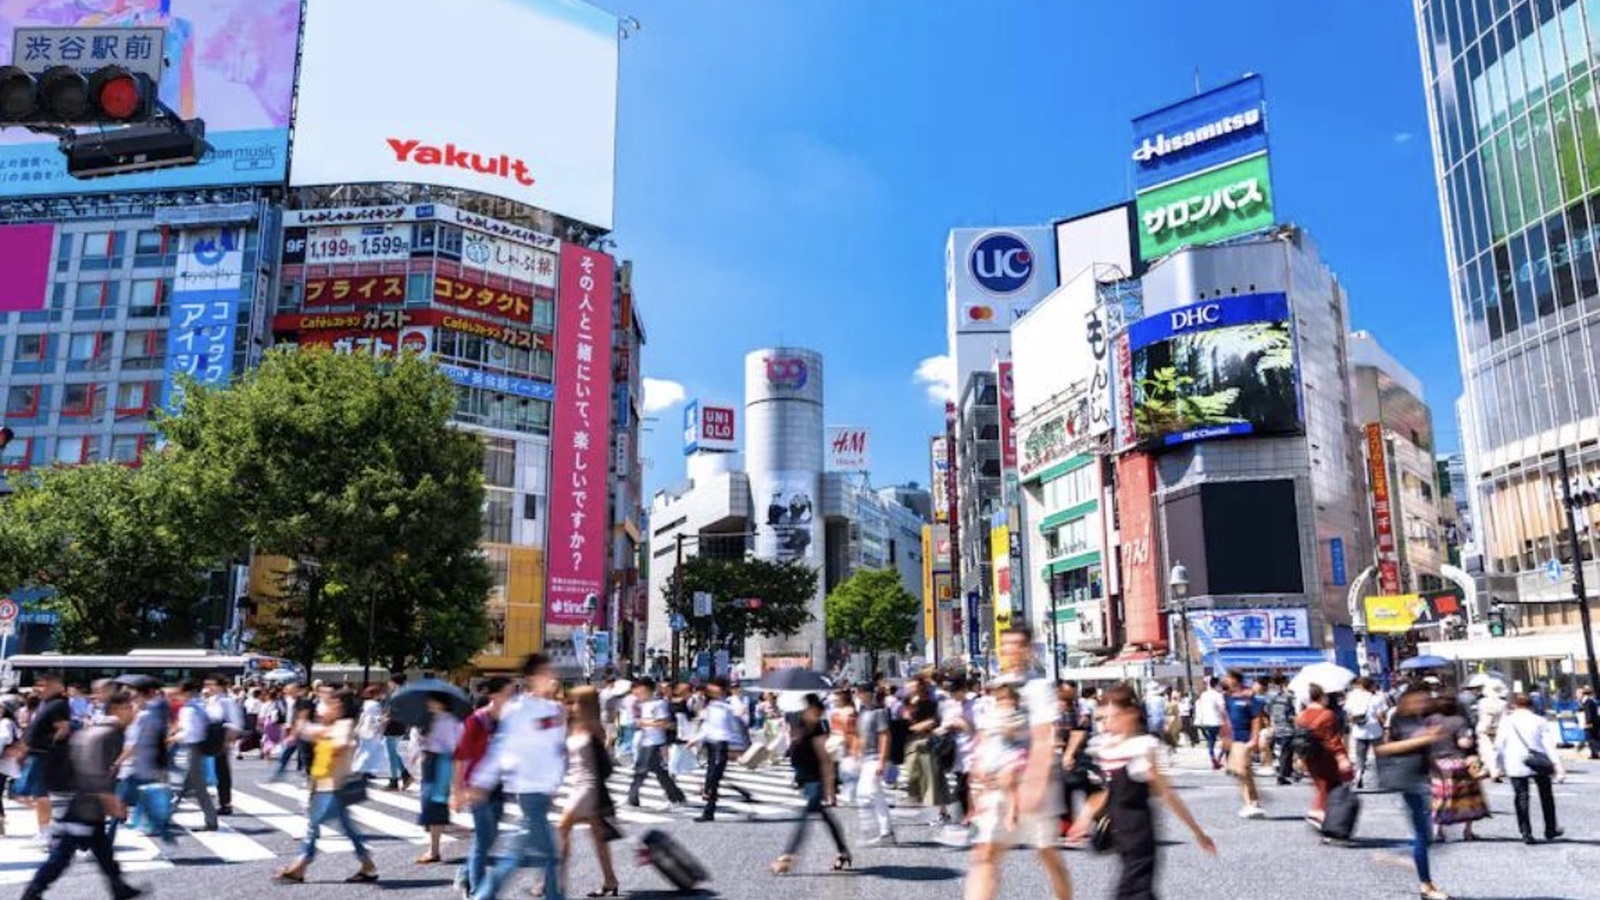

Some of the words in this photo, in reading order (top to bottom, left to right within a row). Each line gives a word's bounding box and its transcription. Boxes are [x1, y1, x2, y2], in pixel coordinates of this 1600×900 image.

[25, 35, 152, 60] 渋谷駅前
[1132, 109, 1260, 161] Hisamitsu
[235, 144, 276, 158] music
[386, 138, 535, 186] Yakult
[1142, 177, 1263, 234] サロンパス
[286, 239, 306, 253] 9F
[434, 278, 529, 316] コンタクト
[363, 310, 411, 329] ガスト
[1171, 304, 1220, 330] DHC
[204, 301, 230, 384] コンタク
[502, 327, 545, 350] ガスト
[705, 410, 729, 423] UNI
[705, 423, 731, 437] QLO
